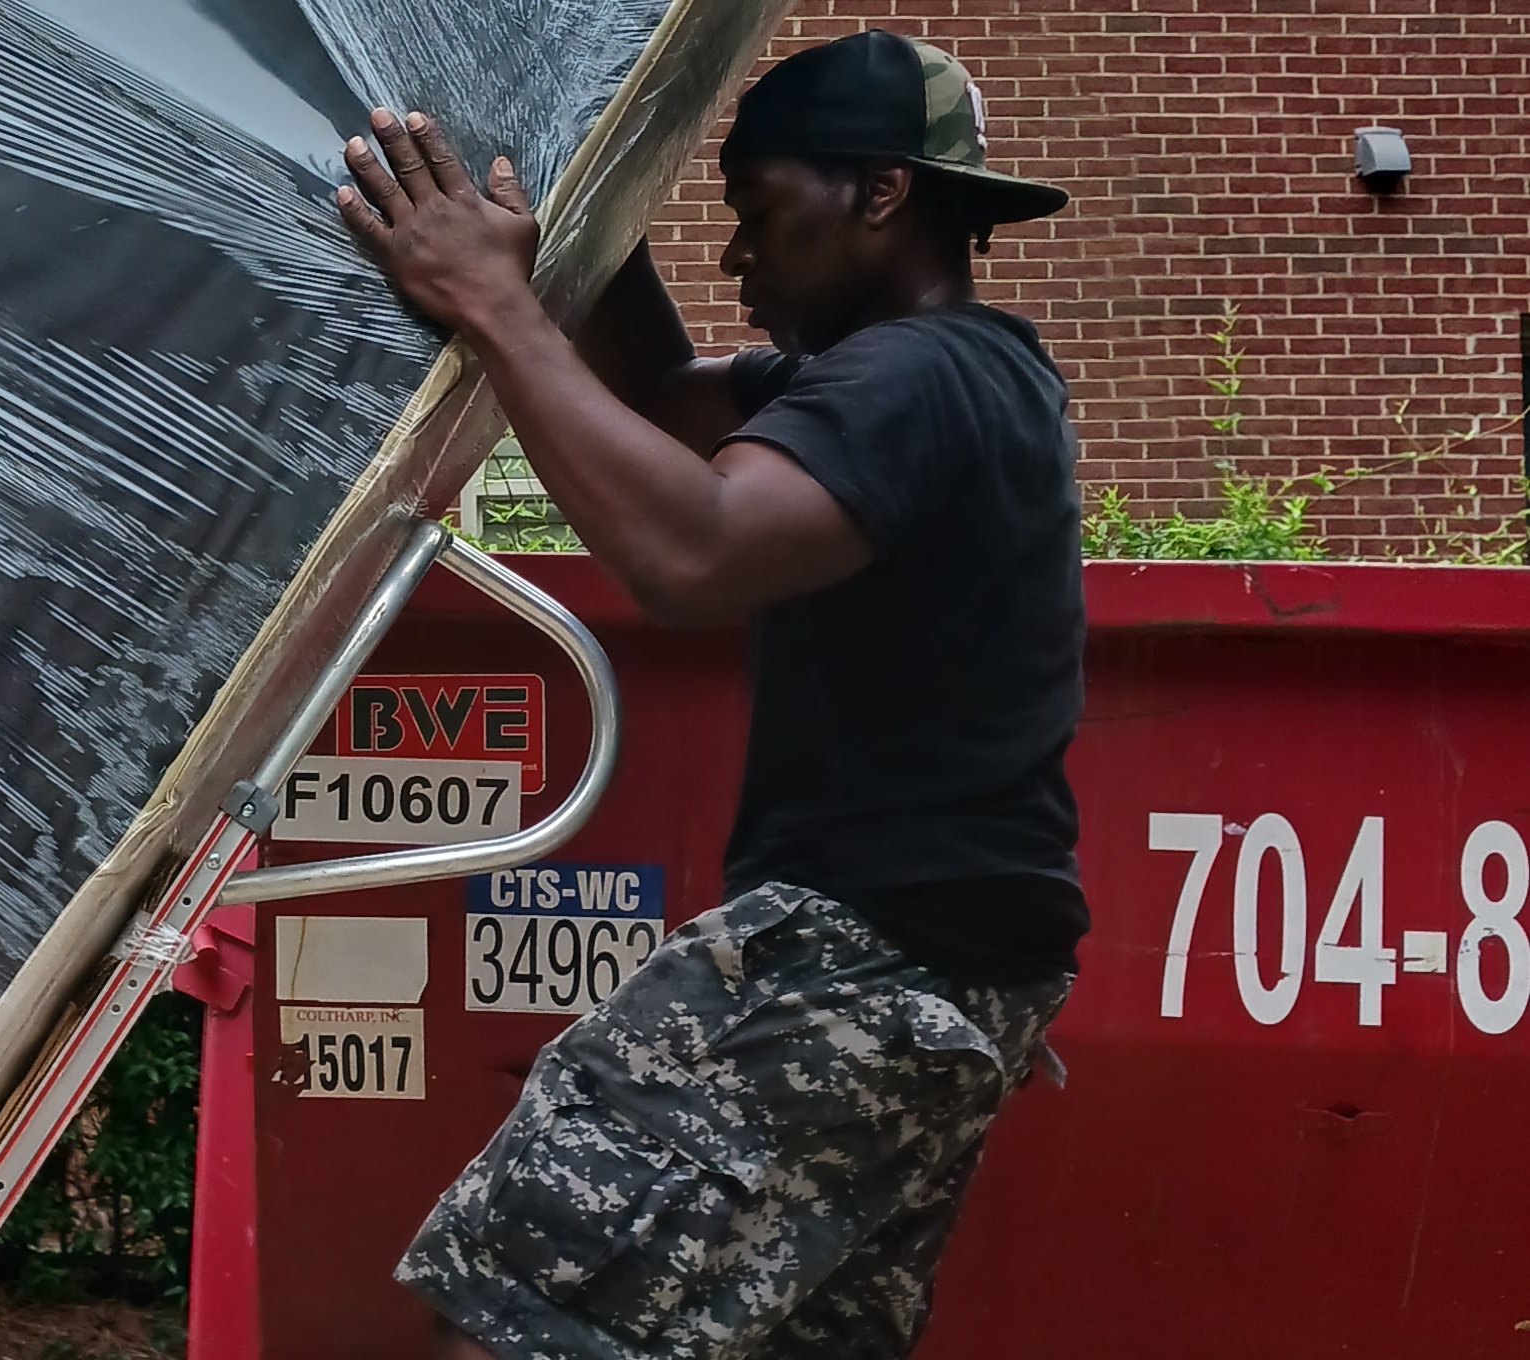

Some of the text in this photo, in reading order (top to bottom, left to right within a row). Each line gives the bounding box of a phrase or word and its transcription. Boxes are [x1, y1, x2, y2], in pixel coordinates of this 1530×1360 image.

[351, 686, 529, 751] BWE
[285, 772, 510, 826] F10607
[491, 869, 640, 911] CTS-WC
[1149, 812, 1530, 1035] 704-8
[380, 1010, 410, 1023] INC.
